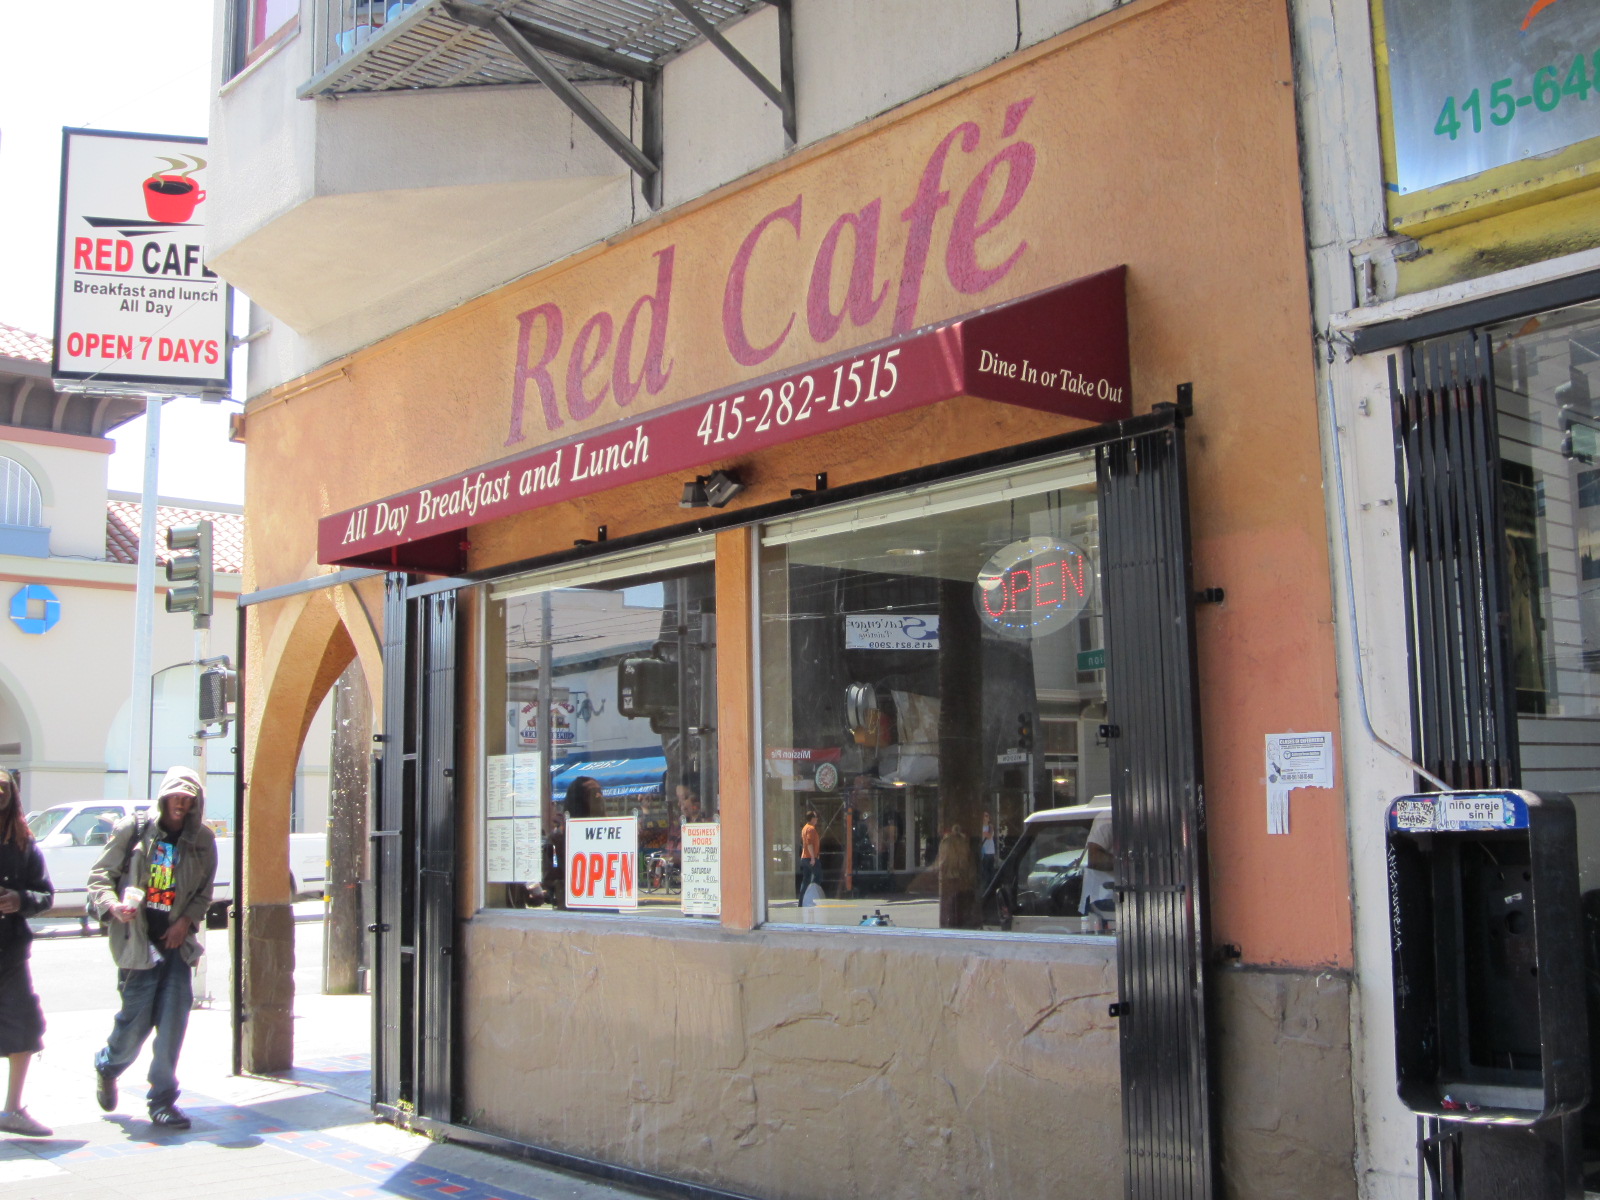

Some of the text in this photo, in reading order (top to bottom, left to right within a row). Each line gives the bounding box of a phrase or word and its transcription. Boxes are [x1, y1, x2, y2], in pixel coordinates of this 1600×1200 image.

[73, 236, 134, 273] RED
[503, 97, 1037, 448] Red Café
[73, 280, 218, 302] Breakfast and lunch
[120, 299, 173, 318] All Day
[66, 331, 219, 365] OPEN 7 DAYS
[978, 349, 1123, 403] Dine In or Take Out
[697, 348, 902, 446] 415-282-1515
[341, 425, 650, 545] All Day Breakfast and Lunch
[983, 554, 1085, 617] OPEN
[1449, 800, 1499, 811] niño ereje
[1468, 810, 1494, 819] sin h
[585, 827, 622, 840] WE'RE
[687, 828, 716, 836] BUSINESS
[571, 851, 634, 898] OPEN
